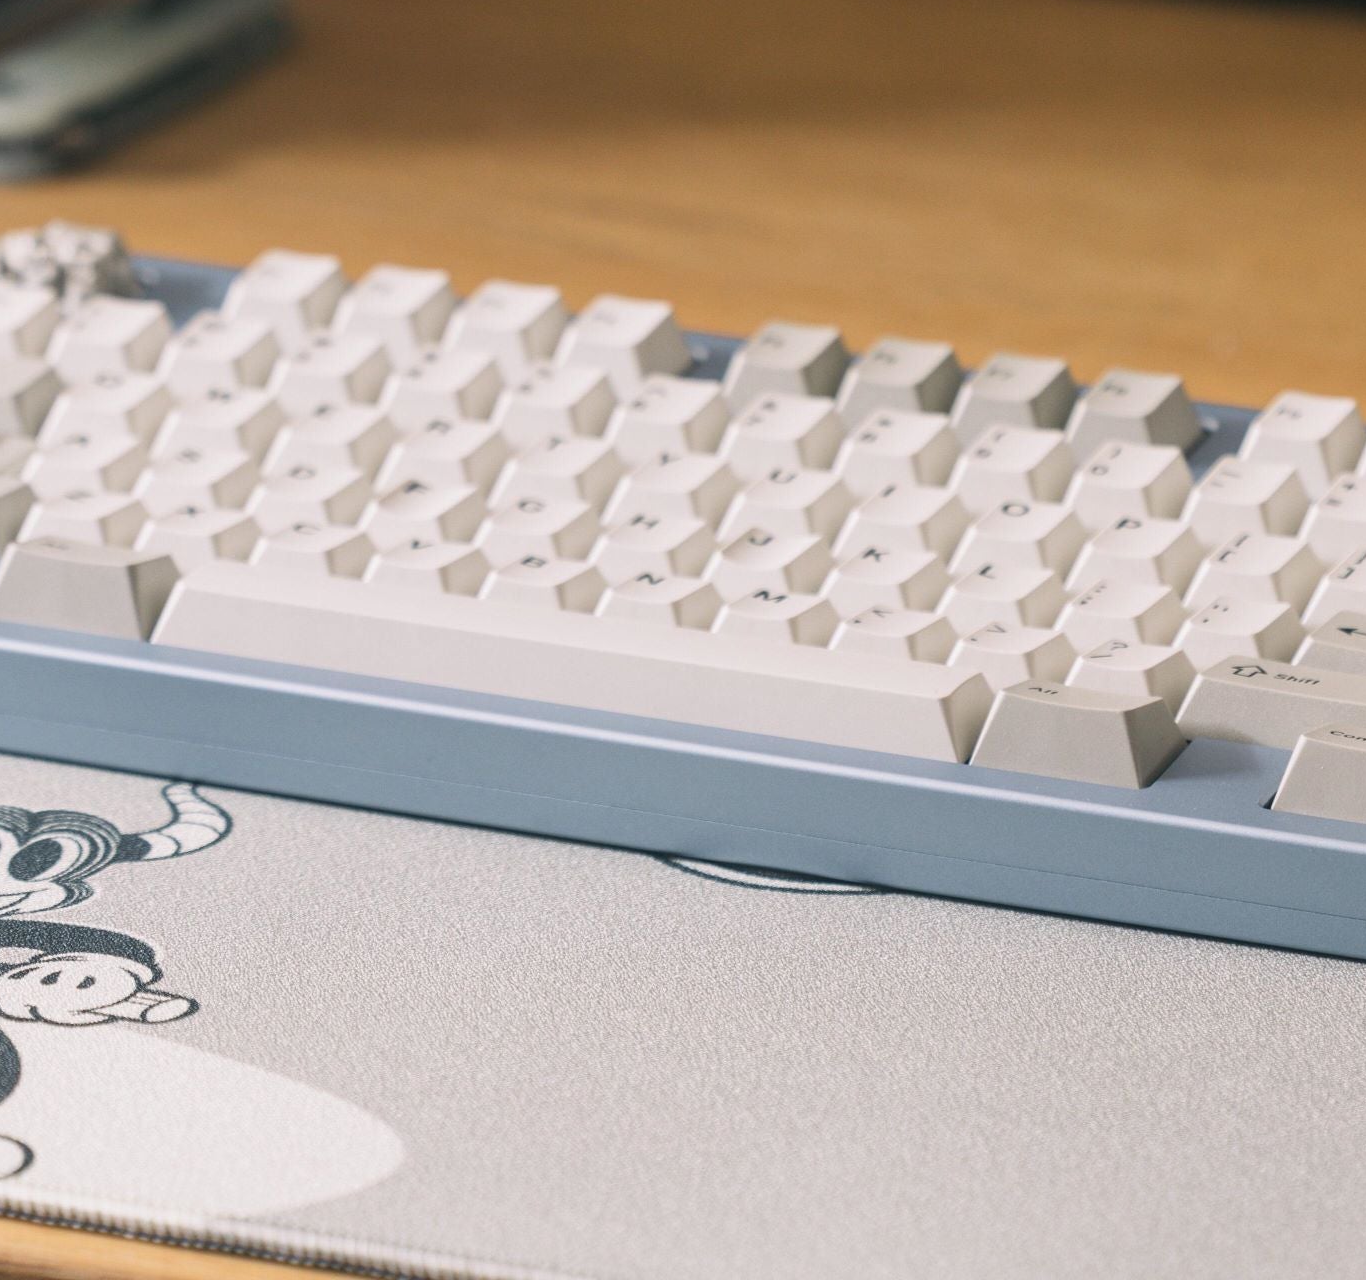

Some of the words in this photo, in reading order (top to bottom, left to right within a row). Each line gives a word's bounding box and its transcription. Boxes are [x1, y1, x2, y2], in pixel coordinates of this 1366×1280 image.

[1114, 517, 1143, 531] P
[635, 573, 666, 586] N
[752, 590, 788, 604] M
[1273, 673, 1321, 686] Shift
[1028, 686, 1059, 696] Alt
